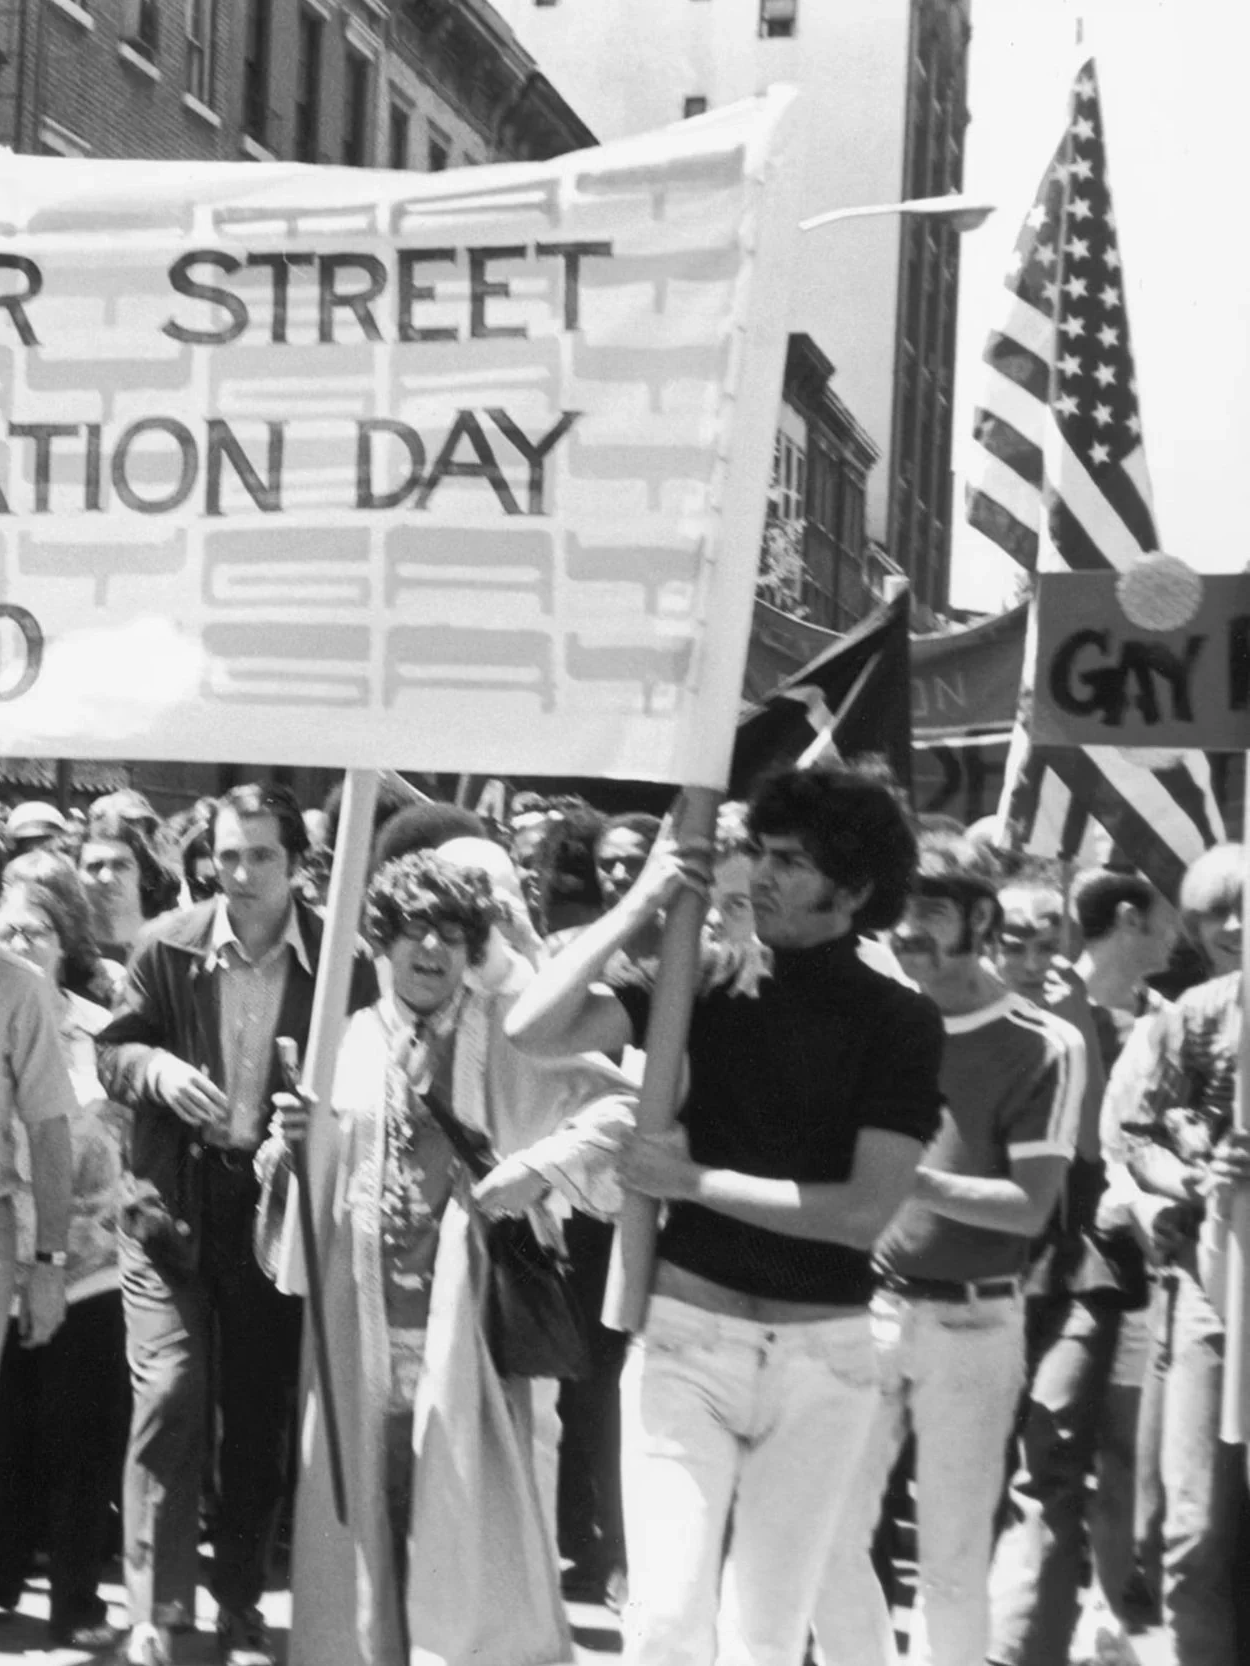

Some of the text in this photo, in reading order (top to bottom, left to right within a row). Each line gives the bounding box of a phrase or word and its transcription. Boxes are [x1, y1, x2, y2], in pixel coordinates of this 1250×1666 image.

[161, 240, 614, 344] STREET
[355, 408, 584, 516] DAY
[1051, 628, 1208, 726] GAY
